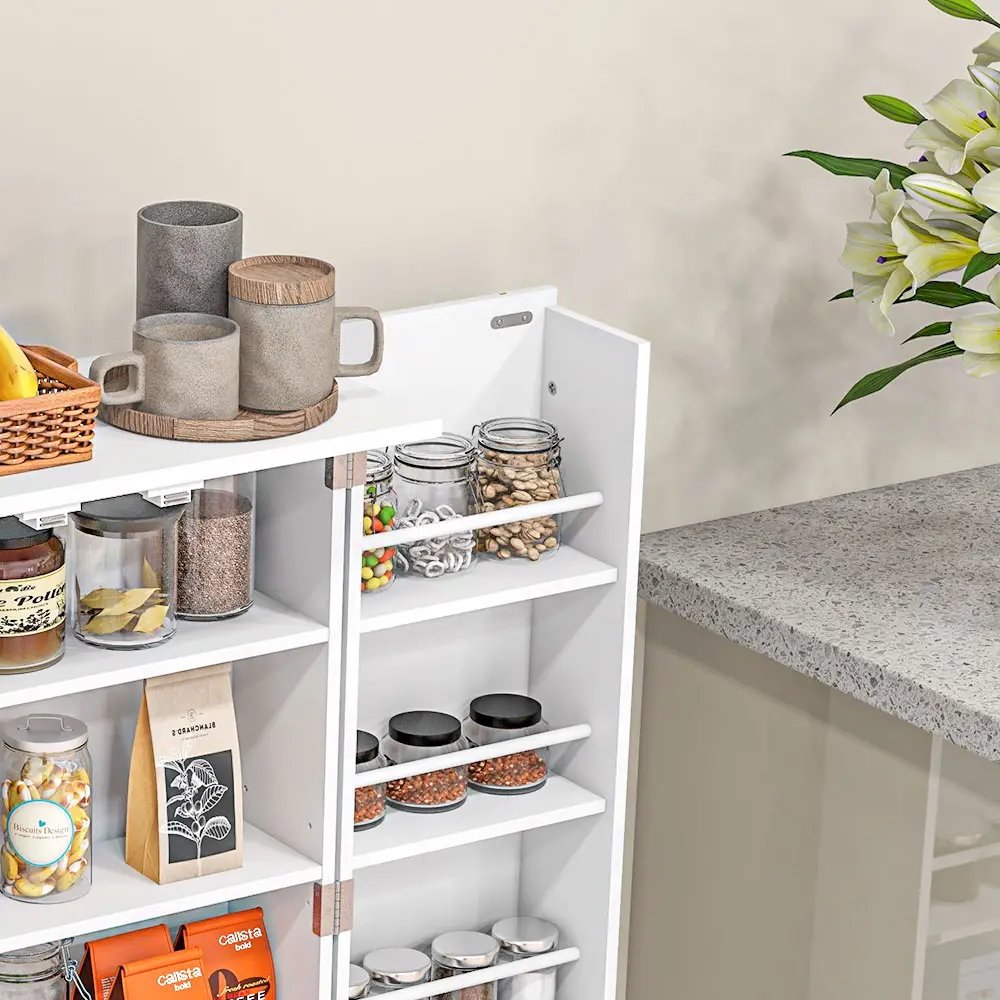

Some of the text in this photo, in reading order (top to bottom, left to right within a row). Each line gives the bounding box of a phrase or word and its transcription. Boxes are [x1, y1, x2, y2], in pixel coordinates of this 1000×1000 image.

[13, 822, 69, 835] Biscuits Design
[234, 941, 252, 952] bold
[173, 981, 192, 992] bold
